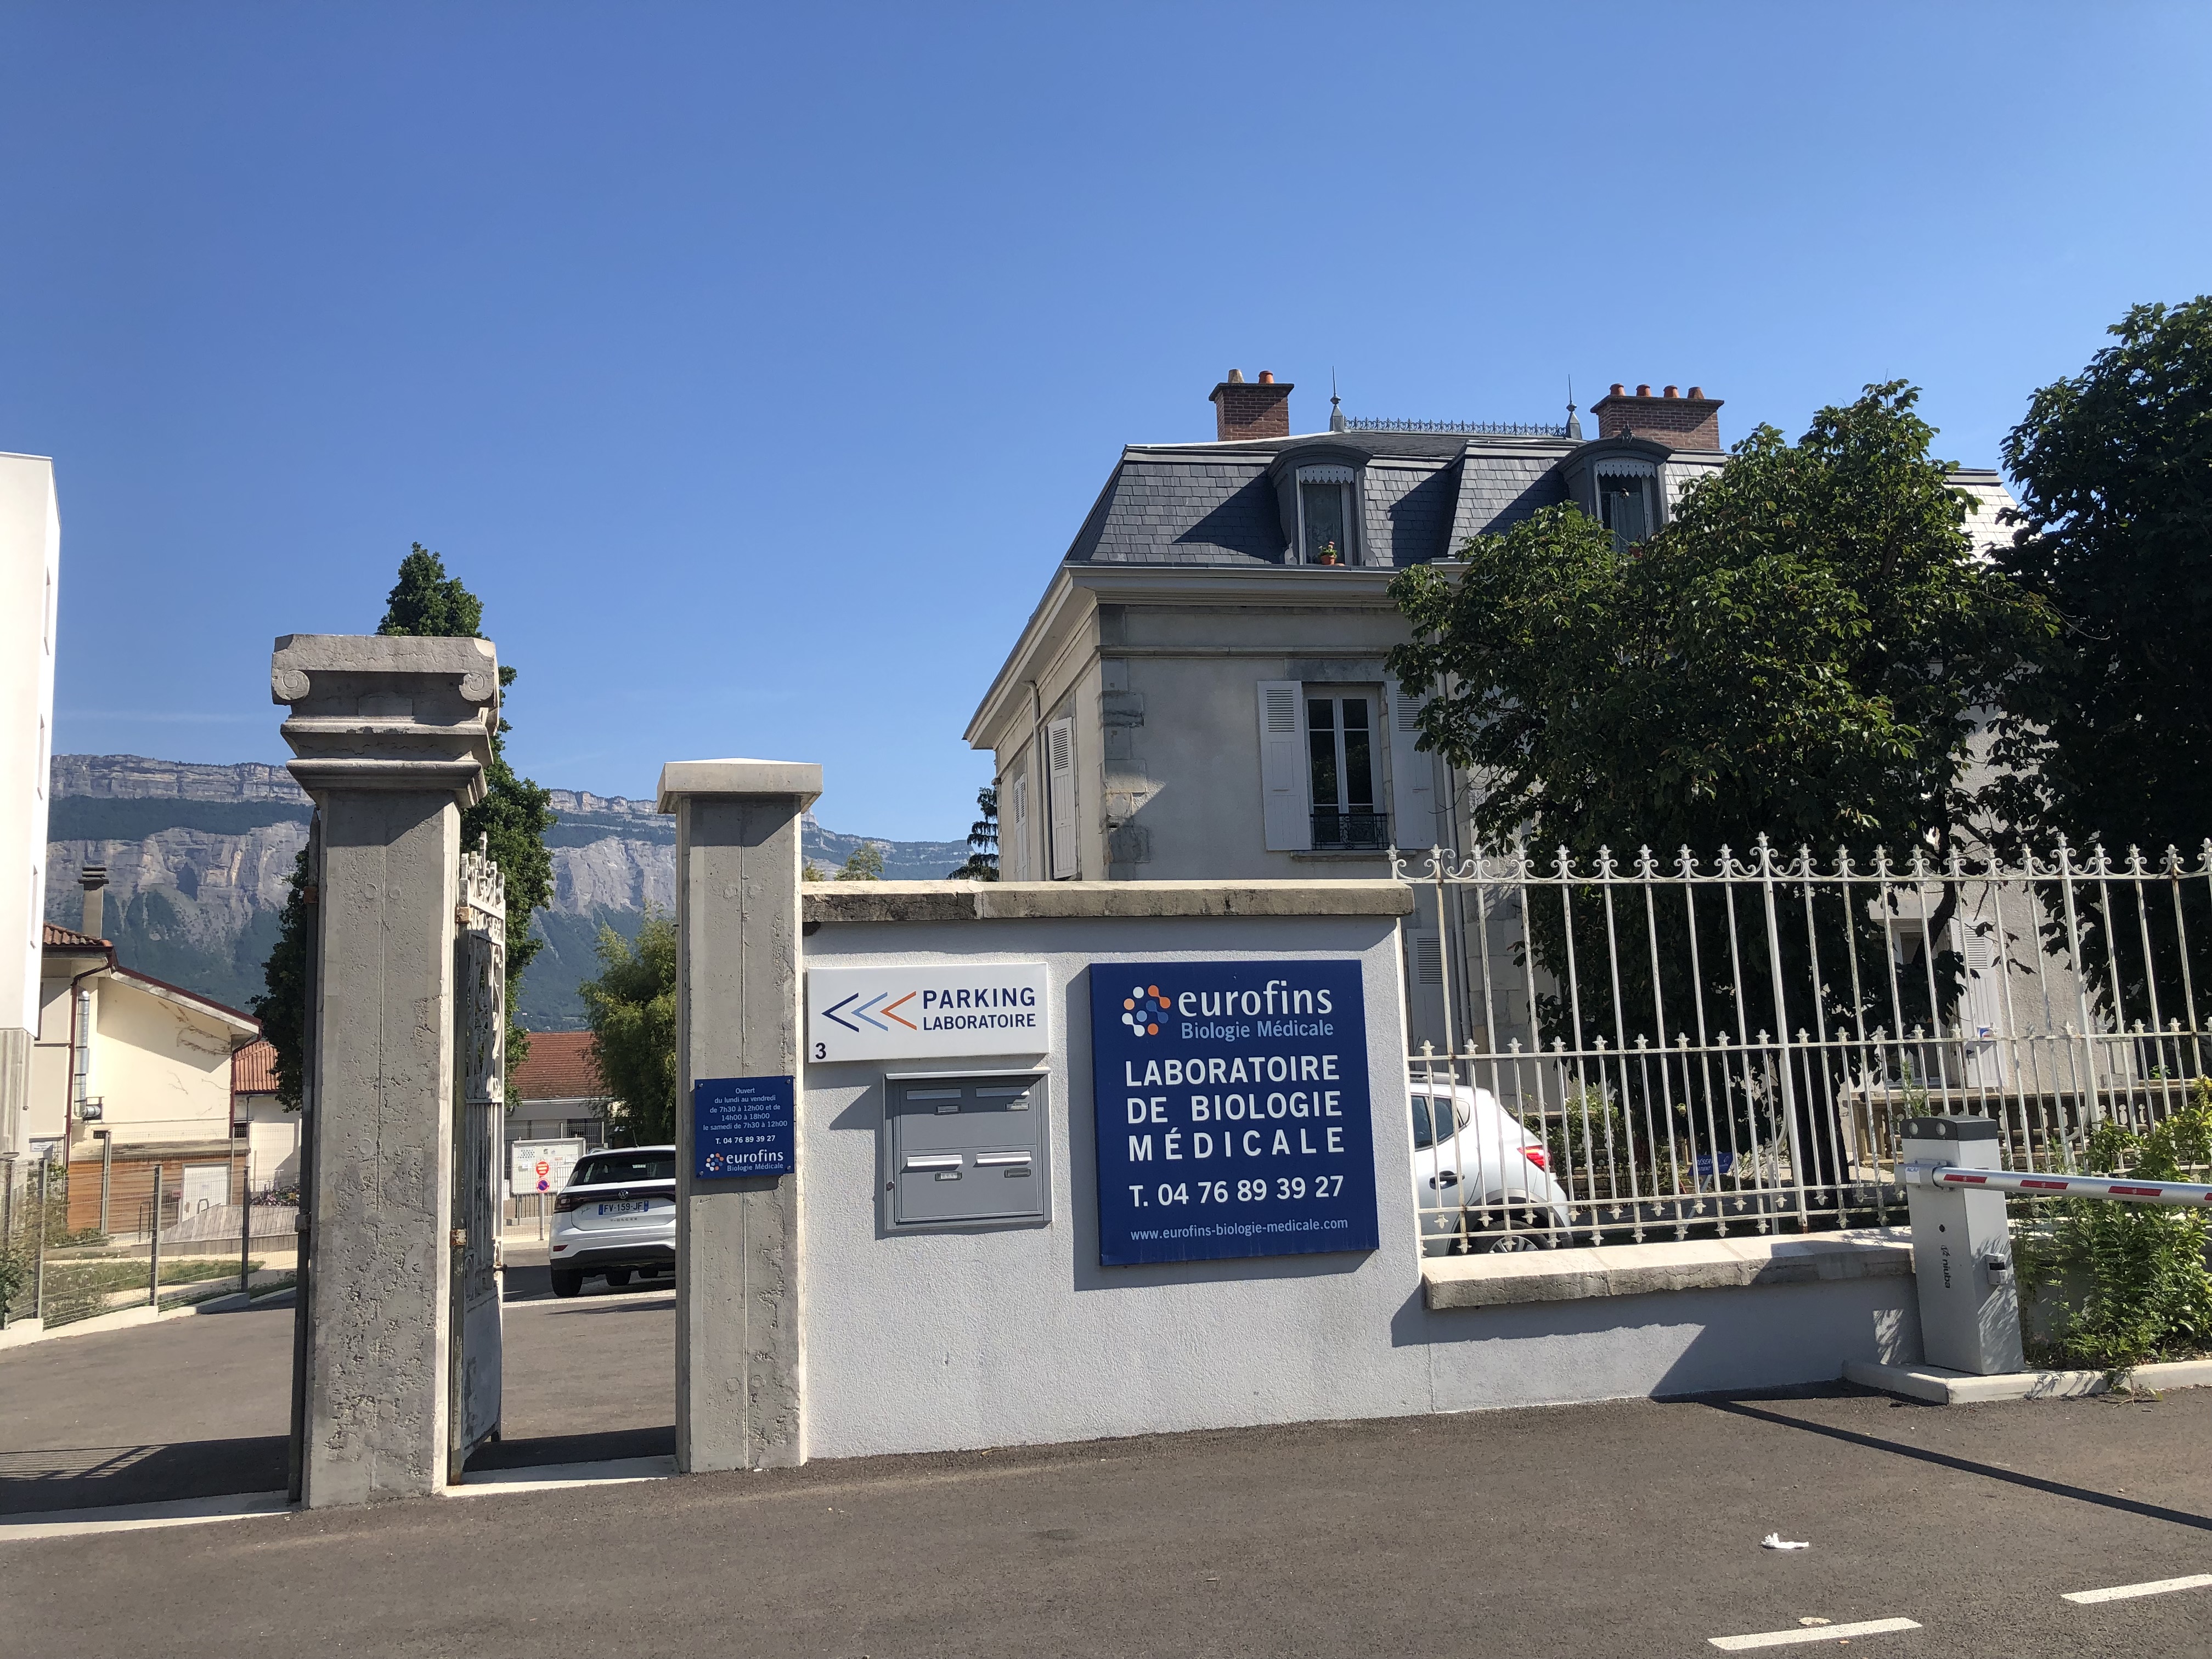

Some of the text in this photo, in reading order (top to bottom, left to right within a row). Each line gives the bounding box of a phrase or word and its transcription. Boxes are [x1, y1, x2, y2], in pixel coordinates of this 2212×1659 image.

[923, 987, 1035, 1009] PARKING
[1178, 980, 1333, 1017] eurofins
[923, 1013, 1036, 1031] LABORATOIRE
[1181, 1019, 1334, 1041] Biologie Médicale
[815, 1042, 827, 1059] 3
[1125, 1055, 1340, 1086] LABORATOIRE
[1127, 1091, 1342, 1124] DE BIOLOGIE
[1128, 1126, 1344, 1162] MÉDICALE
[726, 1149, 783, 1164] eurofins
[1128, 1175, 1344, 1207] T. 04 76 89 39 27
[603, 1201, 643, 1213] FV-159-JF
[1130, 1217, 1348, 1241] www.eurofins-biologie-medicale.com
[1943, 1259, 1951, 1289] niuba
